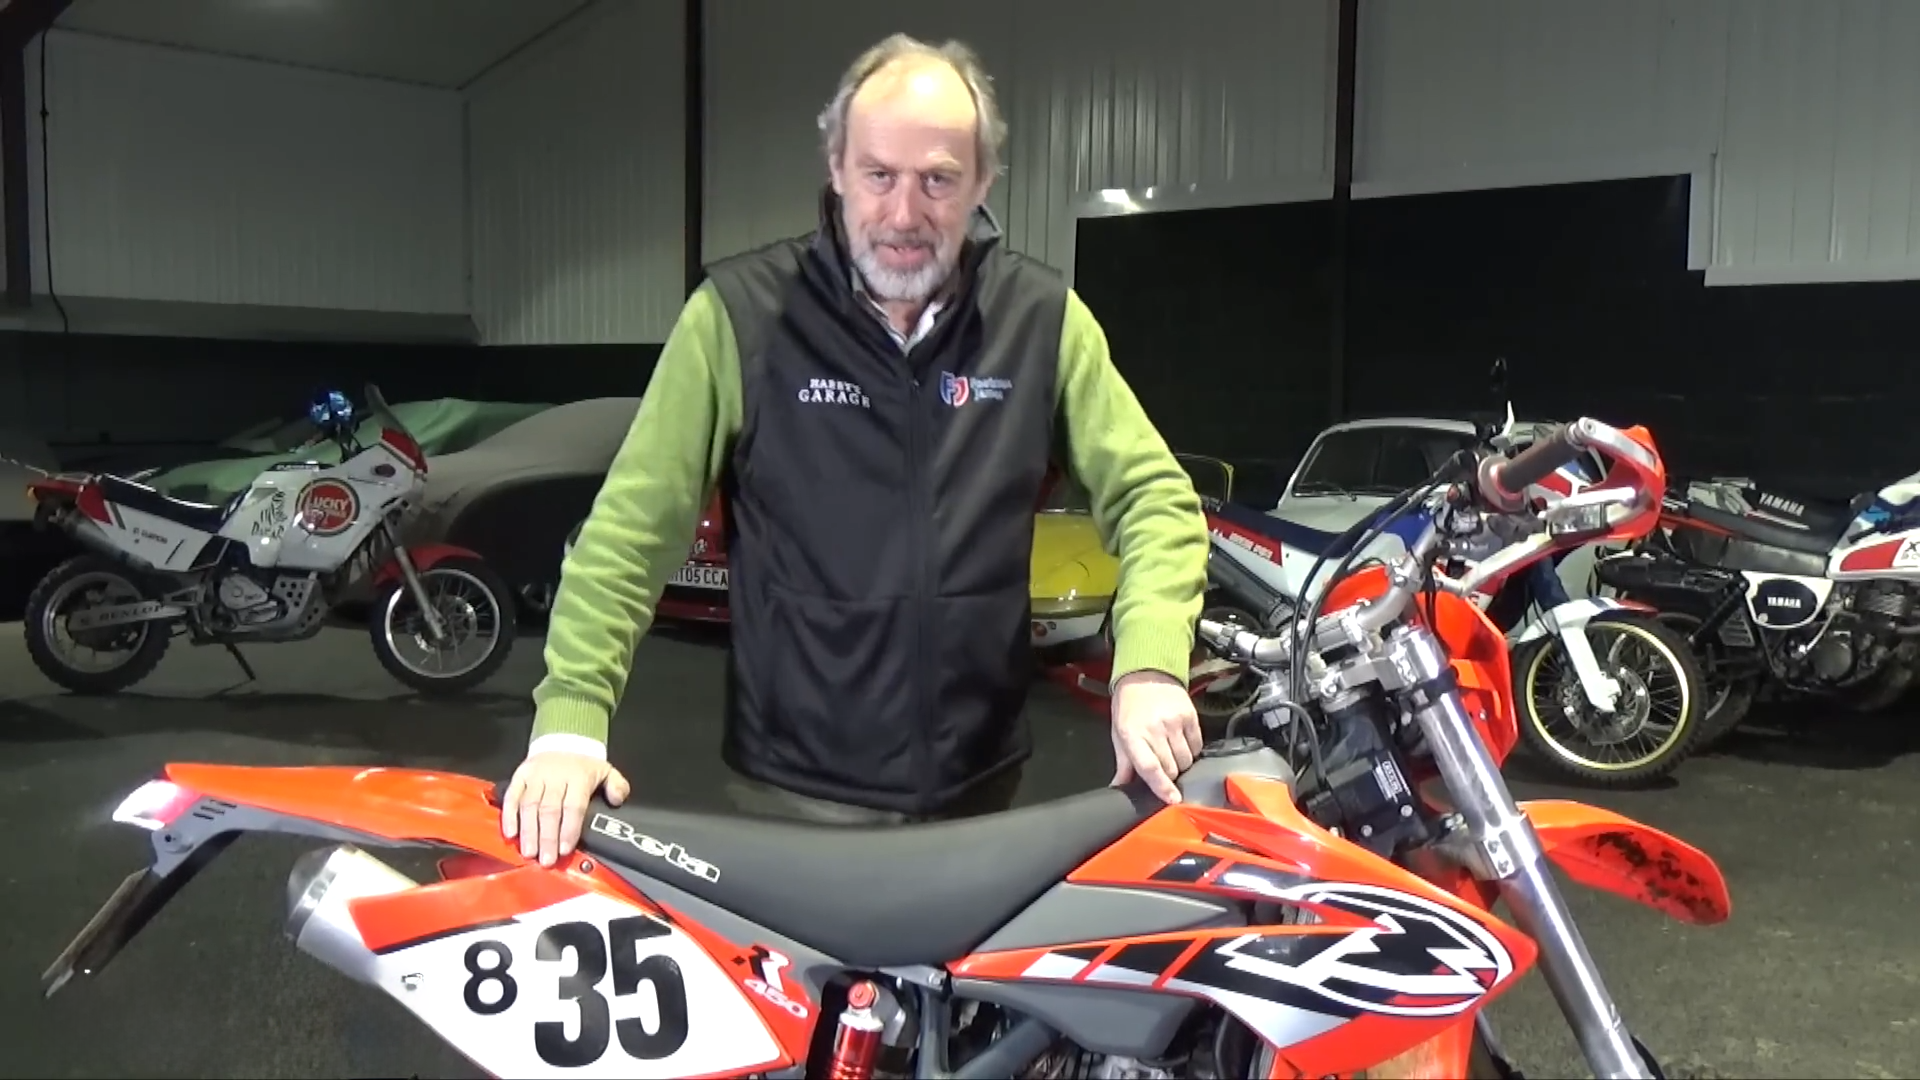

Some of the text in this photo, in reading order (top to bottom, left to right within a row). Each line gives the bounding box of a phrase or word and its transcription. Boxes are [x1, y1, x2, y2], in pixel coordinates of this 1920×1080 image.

[810, 378, 862, 394] HARRY'S
[798, 388, 871, 408] GARAGE
[306, 491, 349, 512] LUCKY
[1760, 492, 1805, 516] YAMAHA
[703, 569, 728, 587] CCA
[1766, 595, 1802, 609] YAMAHA
[590, 812, 721, 884] Beta
[463, 914, 690, 1068] 8 35
[742, 978, 809, 1019] 450
